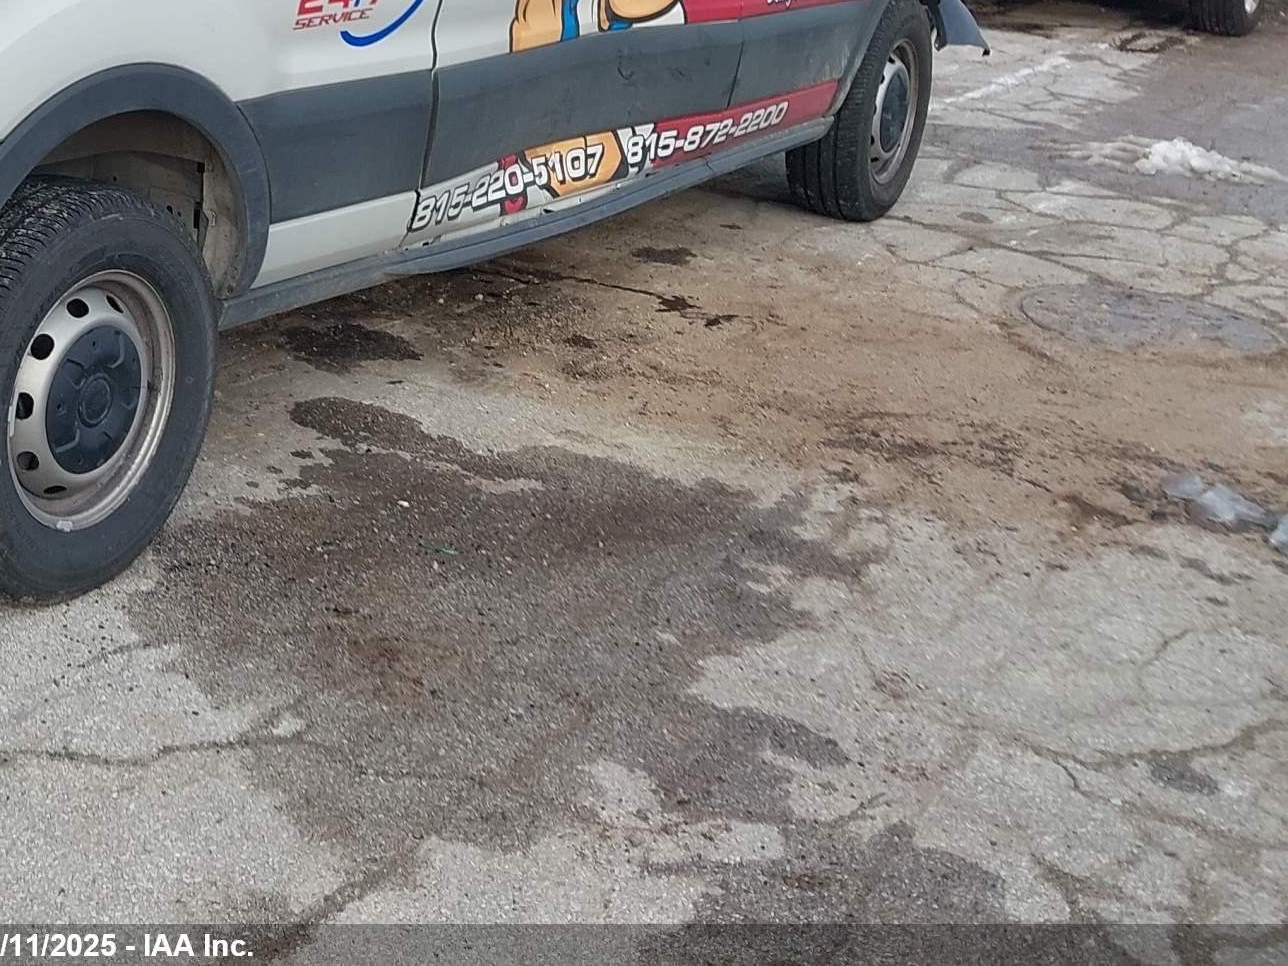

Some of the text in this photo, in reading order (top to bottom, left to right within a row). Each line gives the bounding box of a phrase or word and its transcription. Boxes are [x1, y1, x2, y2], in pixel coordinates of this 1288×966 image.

[293, 8, 373, 31] SERVICE
[411, 100, 789, 232] 815-220-5107 815-872-2200
